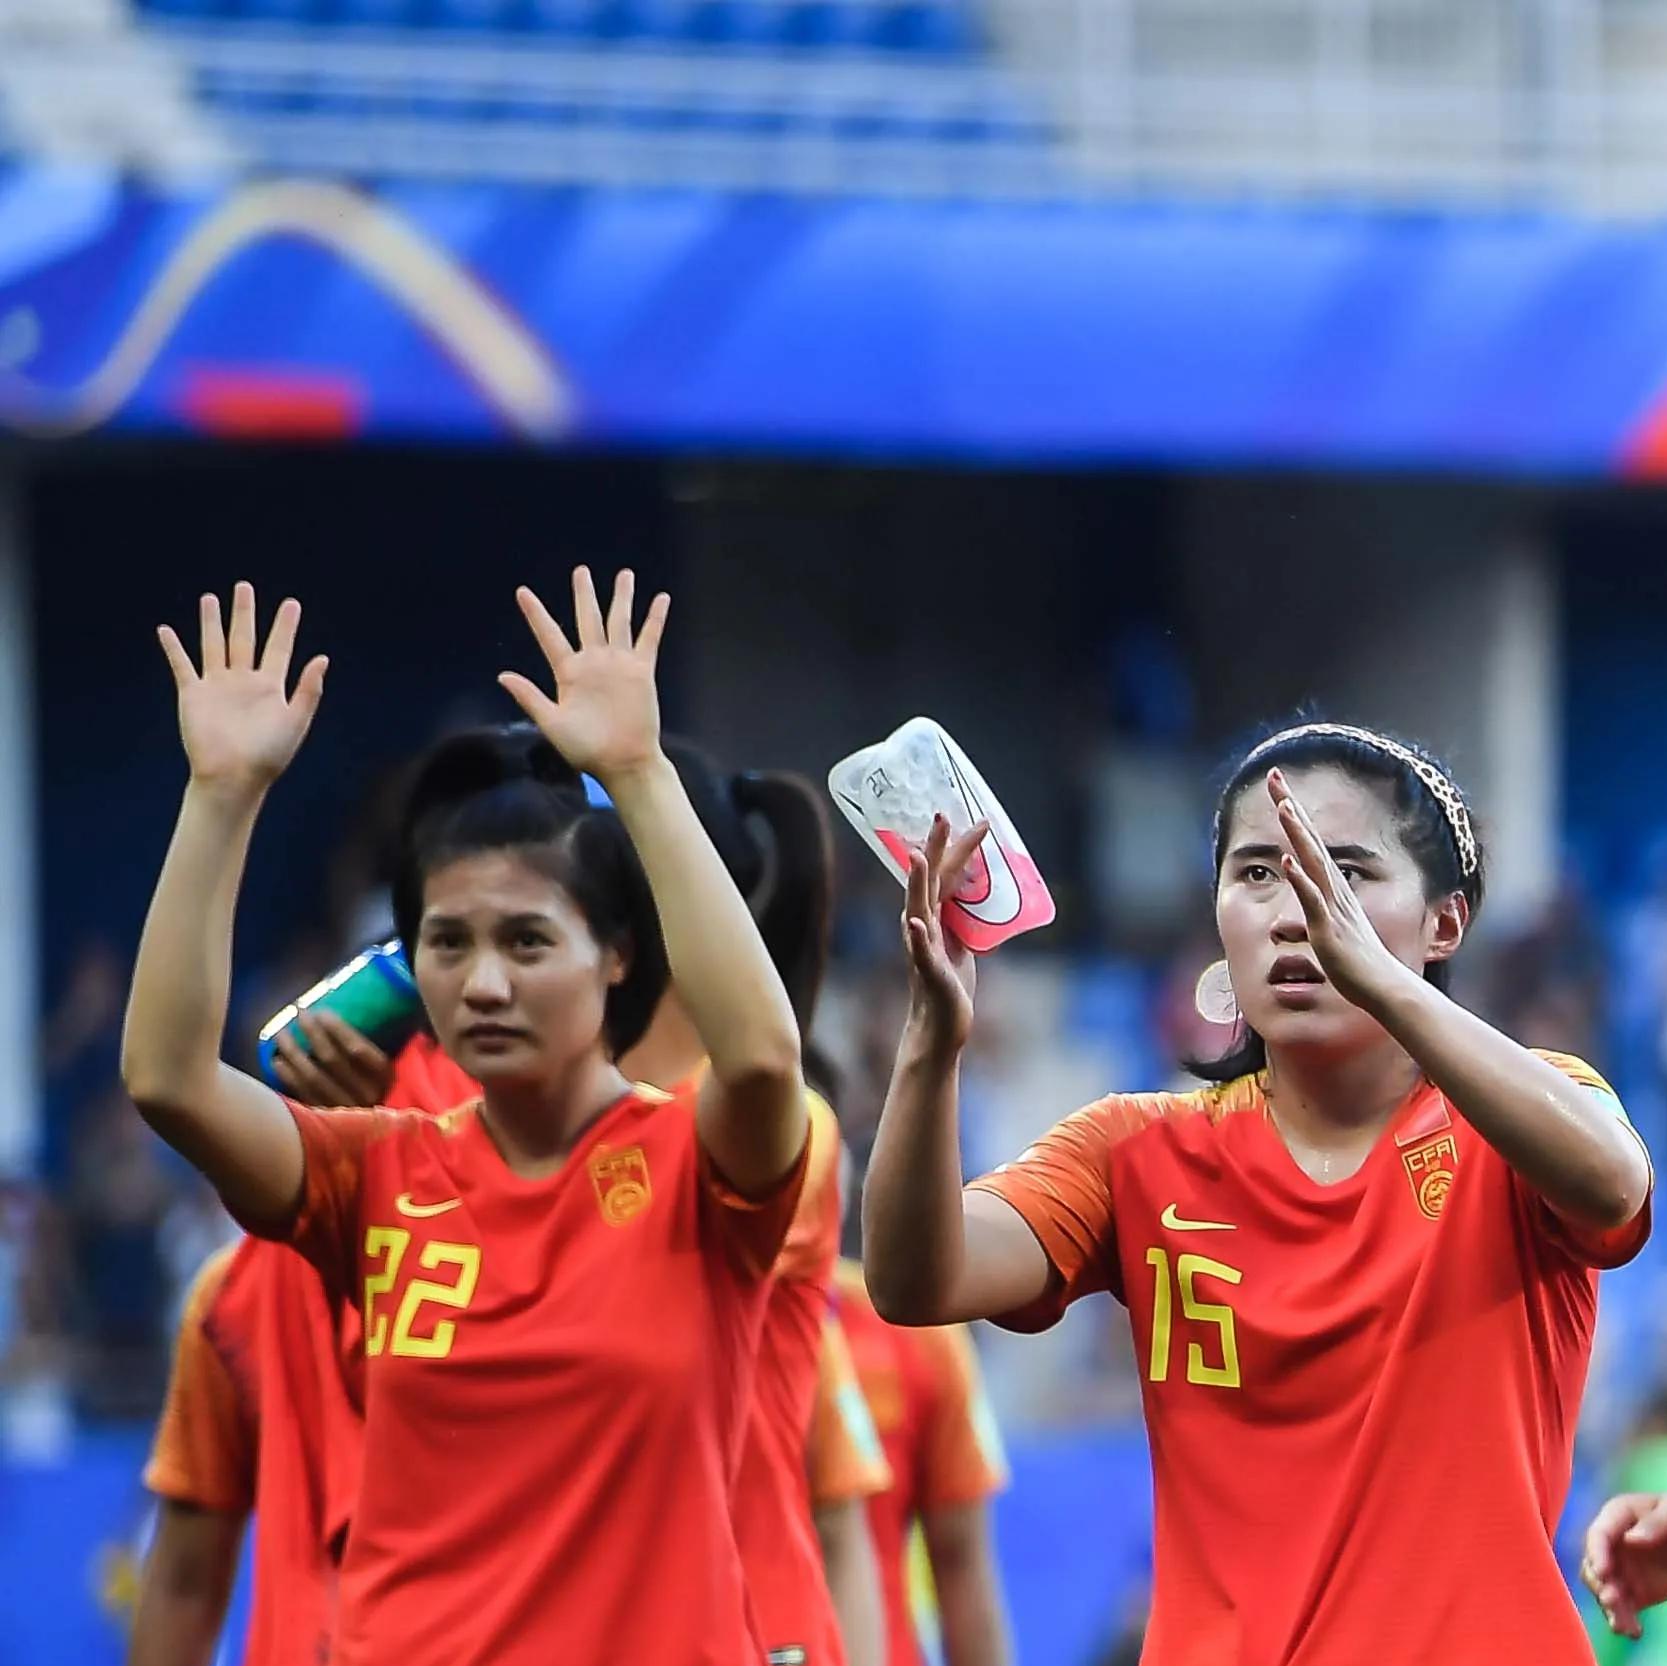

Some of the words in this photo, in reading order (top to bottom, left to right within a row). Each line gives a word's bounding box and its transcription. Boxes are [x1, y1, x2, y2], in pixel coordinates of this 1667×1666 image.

[1407, 1139, 1452, 1172] CFA
[364, 1226, 481, 1359] 22
[1146, 1247, 1243, 1388] 15
